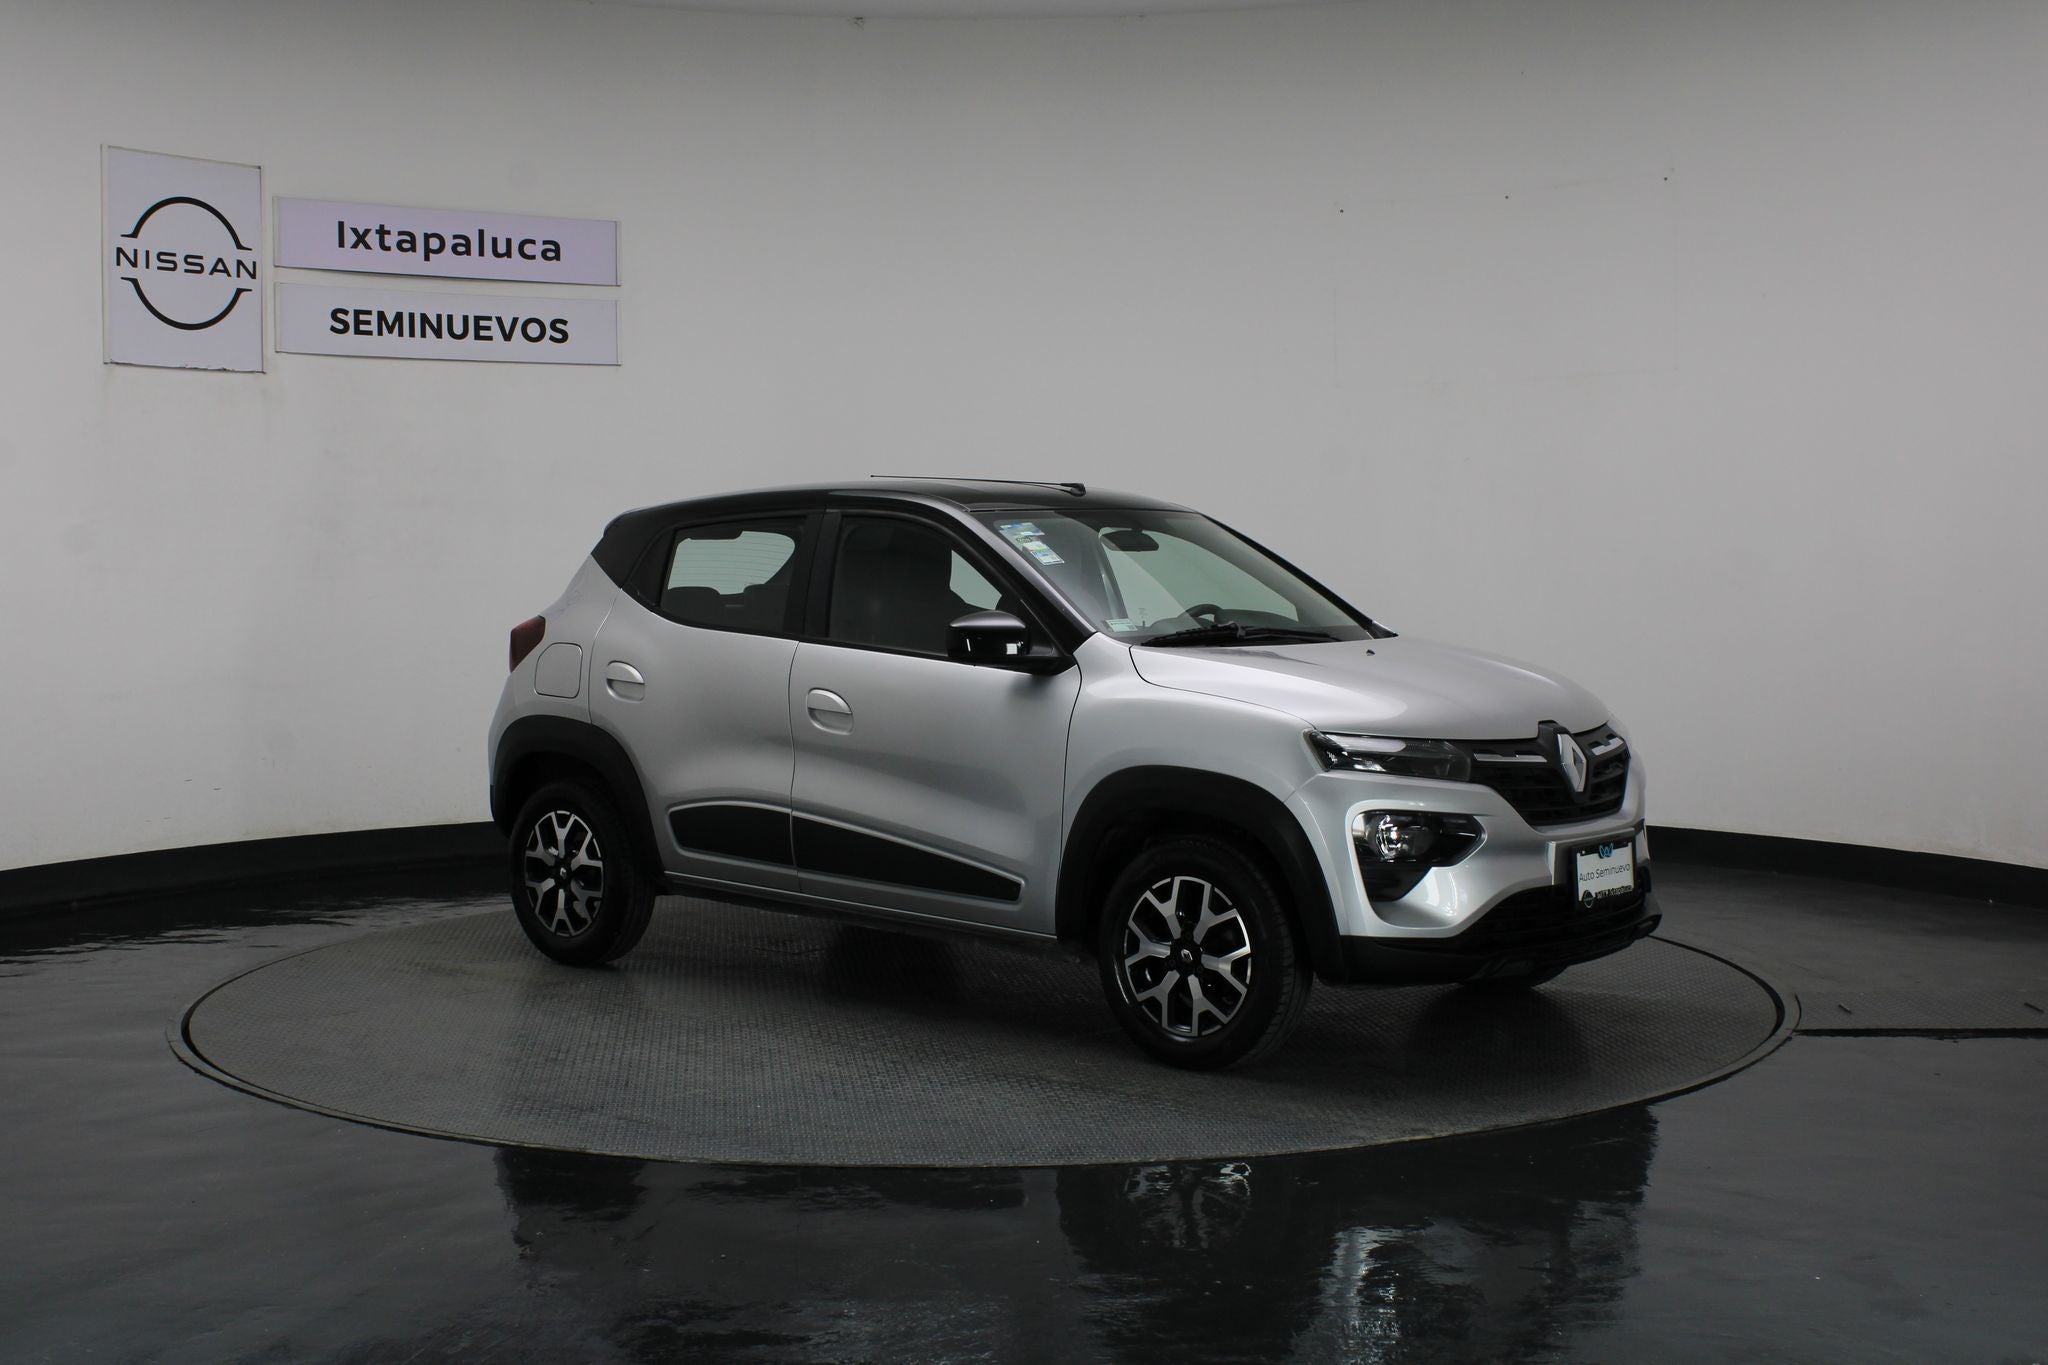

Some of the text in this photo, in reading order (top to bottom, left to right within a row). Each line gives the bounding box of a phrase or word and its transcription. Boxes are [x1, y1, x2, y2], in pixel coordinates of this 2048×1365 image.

[337, 220, 562, 262] Ixtapaluca
[116, 246, 257, 280] NISSAN
[329, 307, 569, 343] SEMINUEVOS
[1579, 863, 1631, 882] Auto Seminuevo
